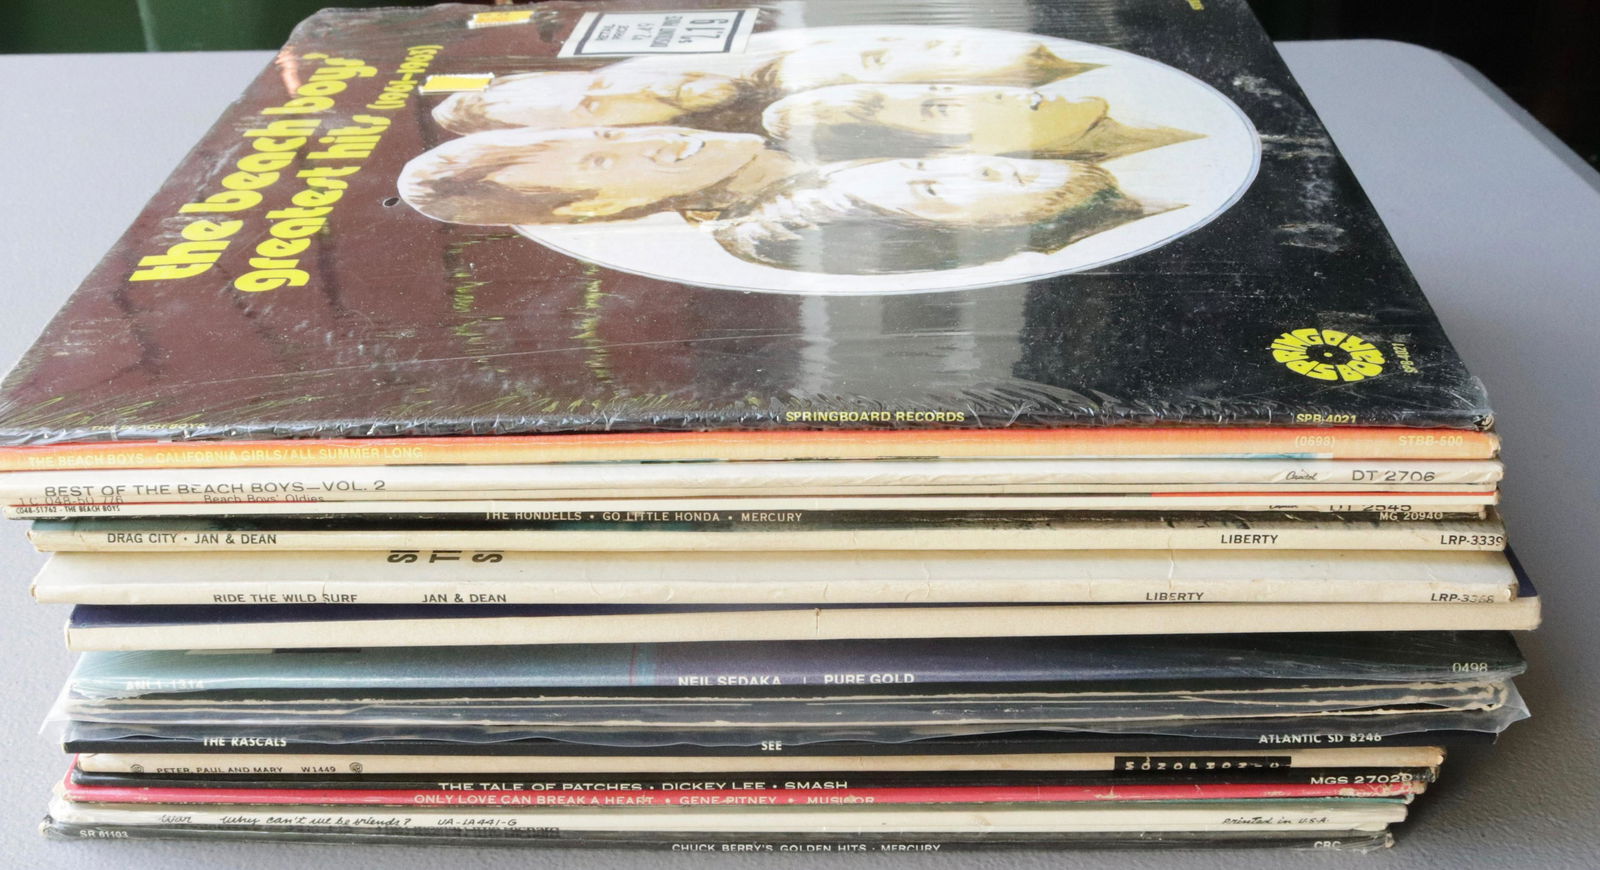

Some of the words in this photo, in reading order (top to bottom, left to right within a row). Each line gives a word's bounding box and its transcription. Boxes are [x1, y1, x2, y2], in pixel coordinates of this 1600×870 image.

[179, 119, 323, 214] beach
[233, 167, 362, 293] greatest
[306, 115, 392, 160] hits
[128, 219, 244, 282] the
[785, 410, 891, 422] SPRINGBOARD
[895, 410, 965, 422] RECORDS
[1296, 413, 1357, 424] SPB-4021
[1398, 435, 1464, 447] STBB-500
[28, 456, 55, 467] THE
[58, 455, 105, 466] BEACH
[107, 454, 145, 466] BOYS
[154, 451, 240, 464] CALIFORNIA
[319, 448, 379, 460] SUMMER
[384, 446, 423, 459] LONG
[1352, 470, 1379, 482] DT
[1384, 470, 1436, 482] 2706
[44, 486, 95, 497] BEST
[101, 485, 127, 496] OF
[133, 484, 174, 495] THE
[177, 483, 244, 495] BEACH
[373, 480, 387, 491] 2
[204, 495, 242, 503] Beach
[285, 494, 325, 503] Oldies
[102, 505, 121, 513] BOYS
[486, 512, 509, 521] THE
[515, 511, 582, 522] HONDELLS
[602, 512, 622, 522] GO
[625, 512, 670, 522] LITTLE
[675, 511, 721, 522] HONDA
[741, 512, 803, 522] MERCURY
[1379, 512, 1398, 521] MG
[1402, 511, 1444, 521] 20940
[107, 533, 143, 544] DRAG
[149, 533, 178, 544] CITY
[194, 533, 219, 545] JAN
[226, 533, 236, 544] &
[241, 533, 277, 545] DEAN
[1220, 534, 1279, 544] LIBERTY
[1440, 535, 1504, 546] LRP-3339
[213, 593, 246, 603] RIDE
[251, 593, 278, 603] THE
[281, 593, 317, 603] WILD
[322, 593, 358, 603] SURF
[421, 593, 448, 603] JAN
[454, 593, 465, 603] &
[469, 593, 507, 603] DEAN
[1145, 592, 1204, 601] LIBERTY
[1452, 662, 1489, 673] 0498
[677, 676, 714, 686] NEIL
[717, 676, 783, 686] SEDAKA
[823, 674, 866, 685] PURE
[869, 673, 917, 685] GOLD
[203, 736, 226, 747] THE
[230, 736, 288, 747] RASCALS
[1258, 734, 1322, 744] ATLANTIC
[1327, 734, 1344, 743] SD
[1349, 733, 1382, 743] 8246
[761, 741, 783, 751] SEE
[438, 782, 474, 791] THE
[480, 782, 525, 791] TALE
[531, 782, 556, 791] OF
[562, 782, 643, 791] PATCHES
[662, 782, 726, 791] DICKEY
[732, 782, 766, 790] LEE
[784, 781, 848, 790] SMASH
[1310, 776, 1351, 785] MGS
[414, 794, 453, 805] ONLY
[458, 794, 497, 805] LOVE
[500, 795, 532, 805] CAN
[537, 795, 586, 805] BREAK
[590, 795, 600, 805] A
[604, 795, 654, 805] HEART
[680, 796, 719, 804] GENE
[725, 796, 777, 804] PITNEY
[266, 816, 307, 824] can't
[335, 816, 351, 825] be
[1277, 816, 1292, 824] in
[79, 829, 97, 838] SR
[671, 843, 716, 852] CHUCK
[721, 843, 774, 852] BERRY'S
[779, 844, 832, 852] GOLDEN
[838, 843, 867, 852] HITS
[881, 843, 942, 852] MERCURY
